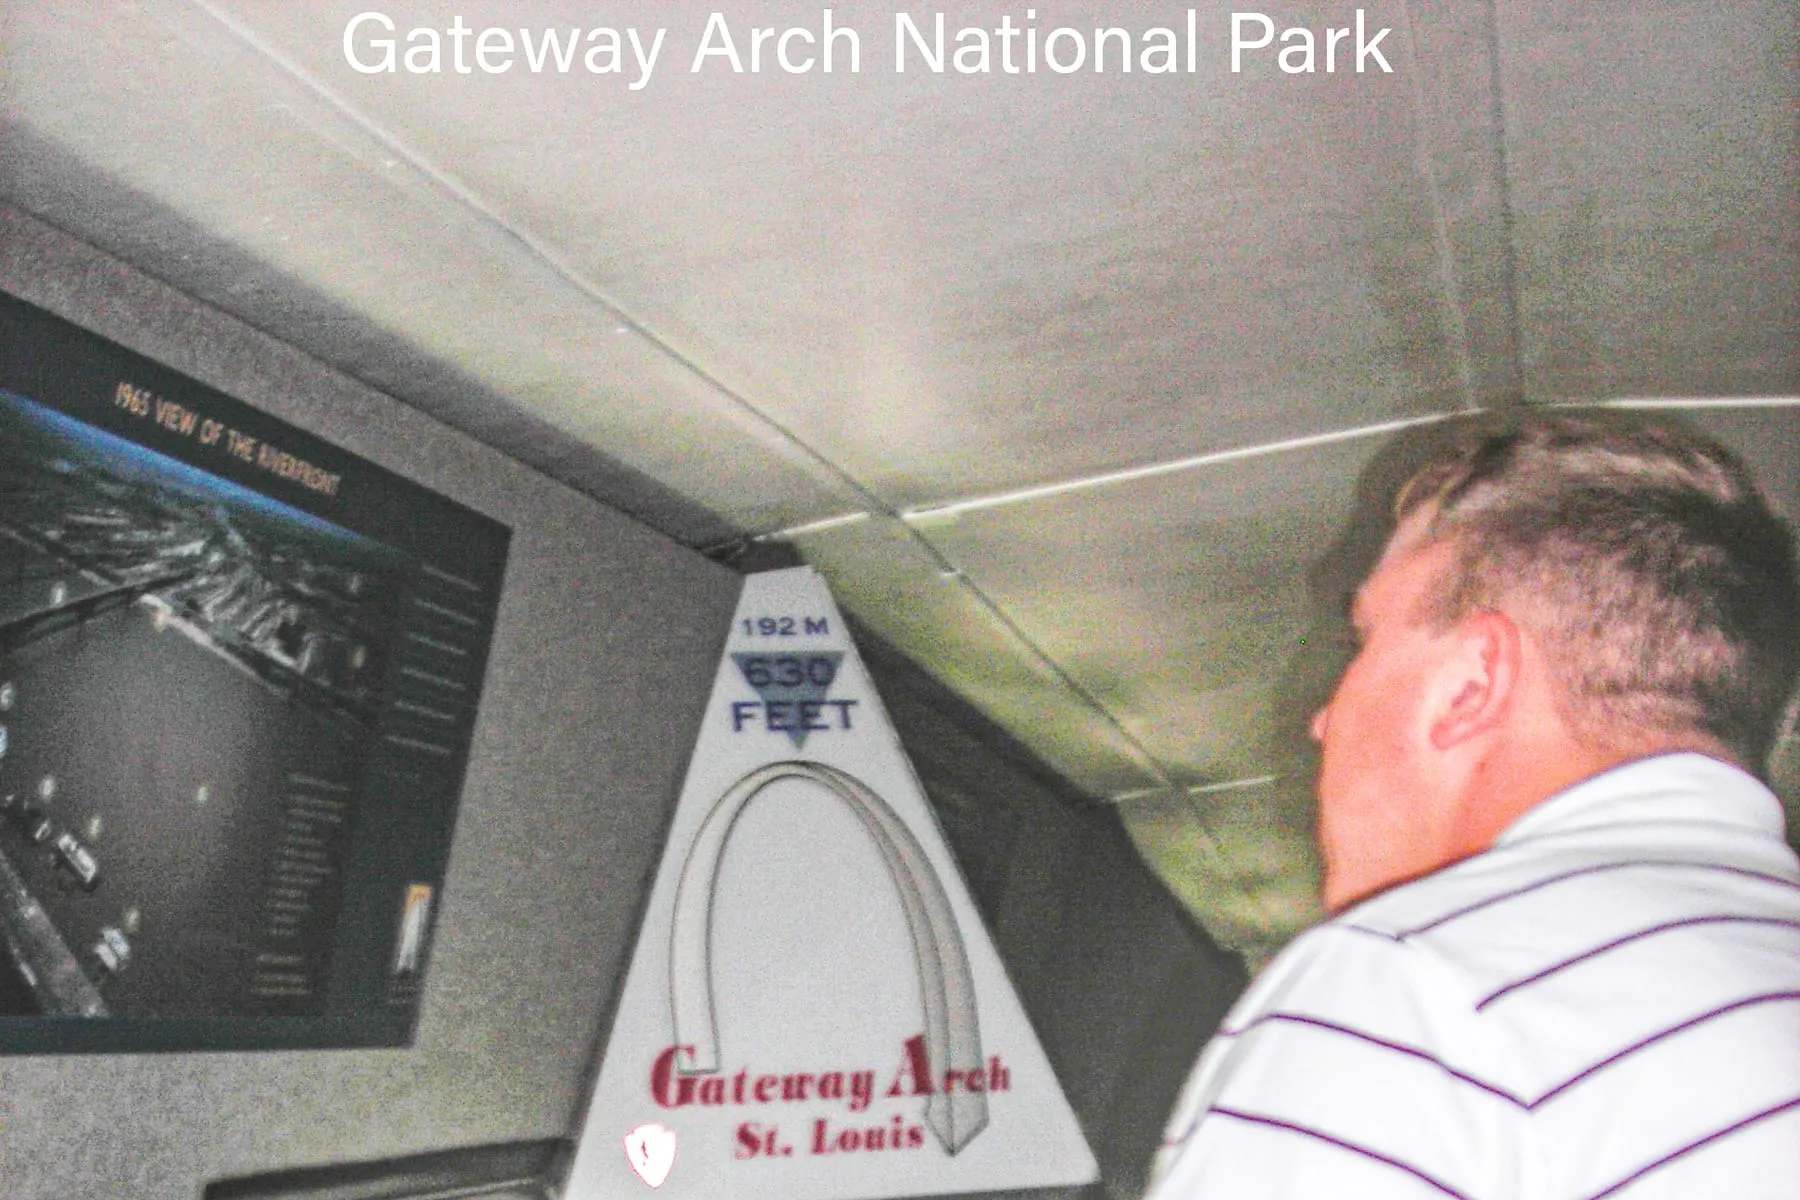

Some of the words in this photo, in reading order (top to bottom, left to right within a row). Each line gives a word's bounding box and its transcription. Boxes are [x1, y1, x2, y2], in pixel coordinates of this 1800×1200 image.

[115, 382, 151, 416] 1965
[155, 397, 198, 436] VIEW
[200, 419, 224, 445] OF
[227, 429, 257, 462] THE
[743, 616, 797, 636] 192
[804, 616, 829, 635] M
[746, 657, 834, 687] 630
[731, 700, 857, 732] FEET
[650, 1044, 874, 1112] Gateway
[886, 1034, 1012, 1098] Arch
[735, 1120, 792, 1160] St.
[810, 1115, 925, 1156] Louis
